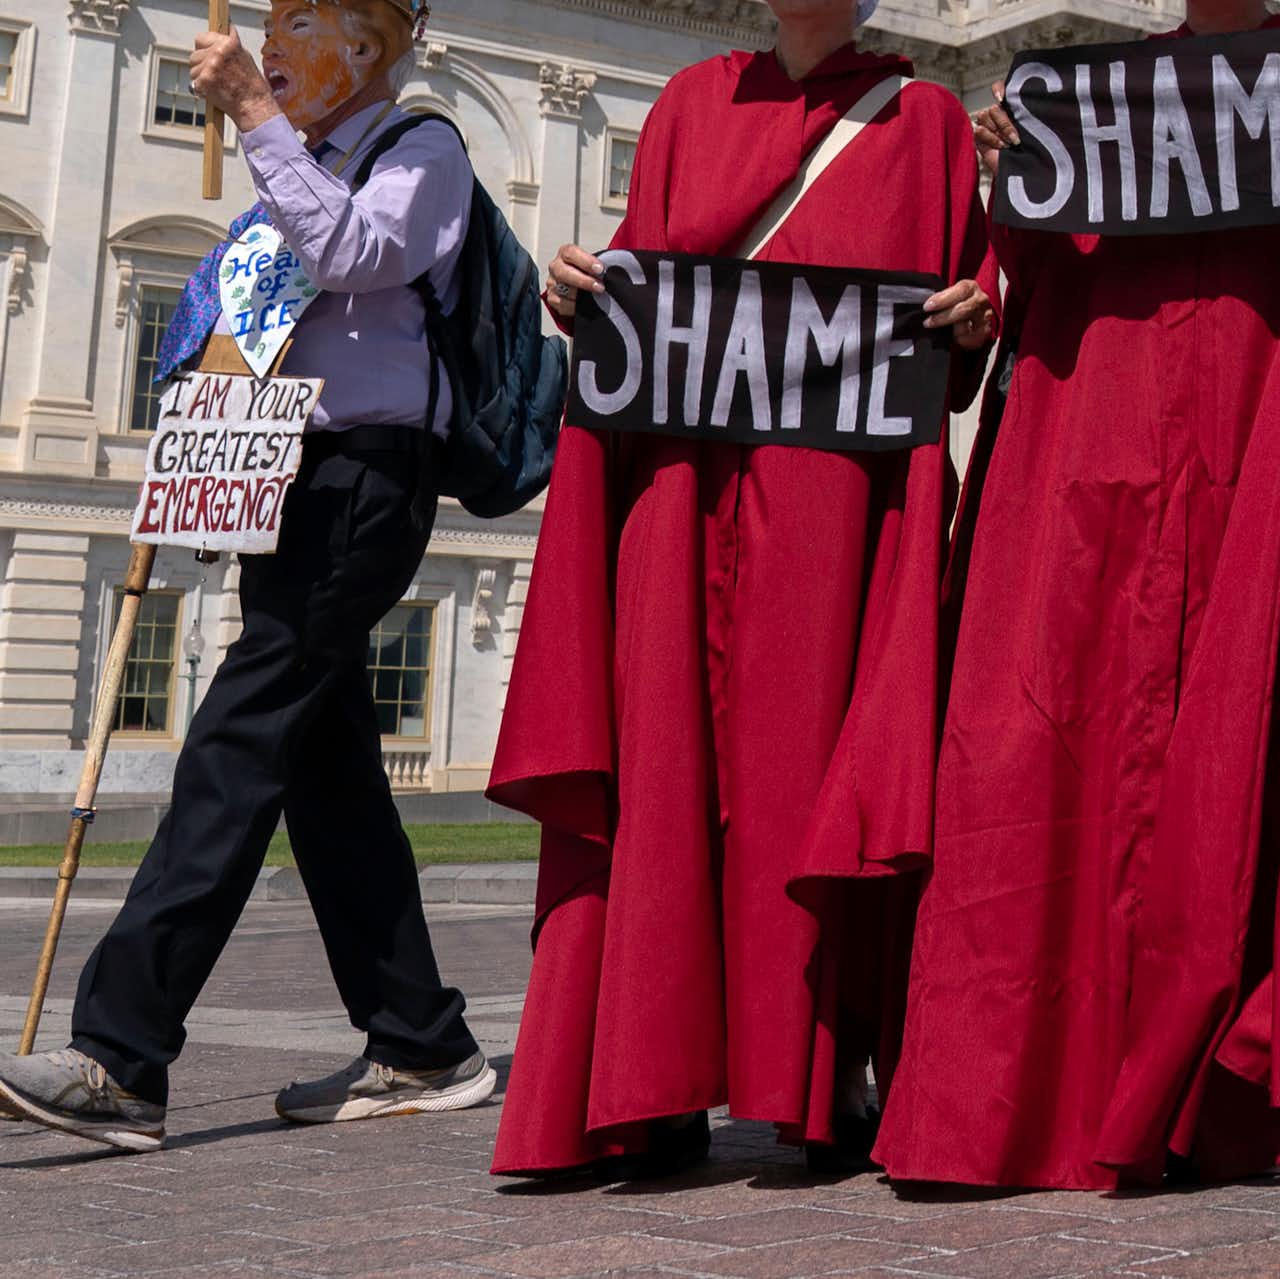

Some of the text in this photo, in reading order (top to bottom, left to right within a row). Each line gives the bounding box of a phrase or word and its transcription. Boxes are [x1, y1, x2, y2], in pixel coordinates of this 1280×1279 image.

[257, 270, 290, 301] of
[578, 249, 935, 436] SHAME
[162, 375, 313, 420] I AM YOUR
[153, 429, 301, 473] GREATEST
[137, 473, 294, 534] EMERGENCY
